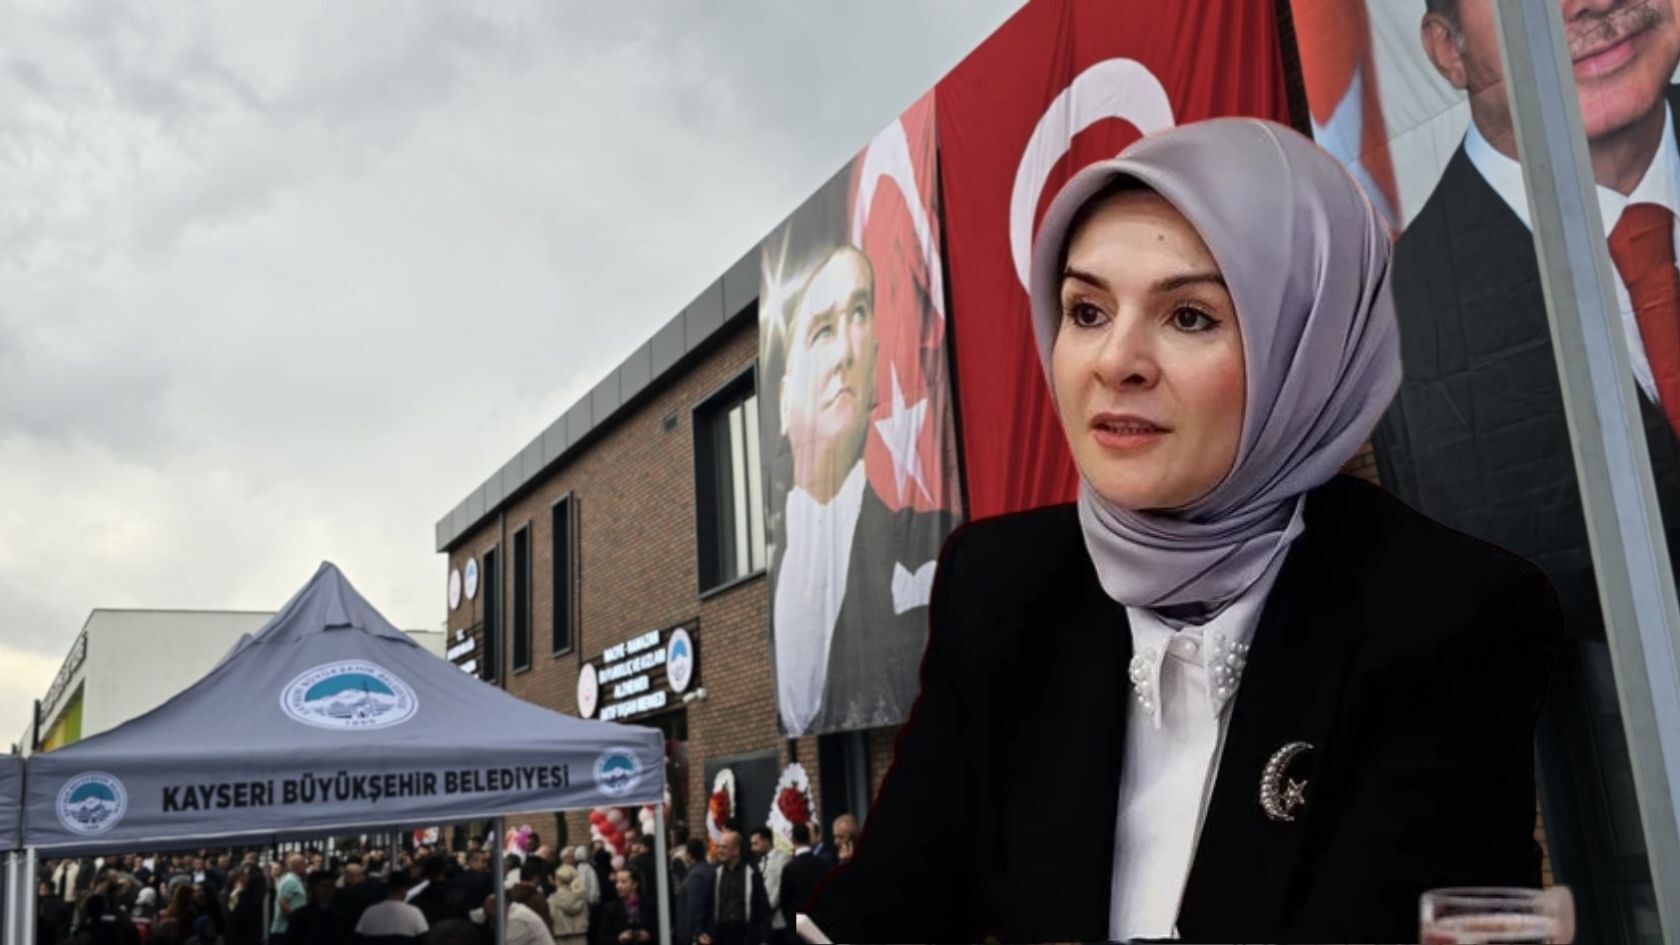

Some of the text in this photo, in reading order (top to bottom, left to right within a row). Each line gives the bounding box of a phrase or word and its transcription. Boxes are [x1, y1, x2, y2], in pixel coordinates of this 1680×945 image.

[162, 779, 275, 813] KAYSERİ
[282, 771, 438, 805] BÜYÜKŞEHİR
[444, 763, 570, 795] BELEDİYESİ
